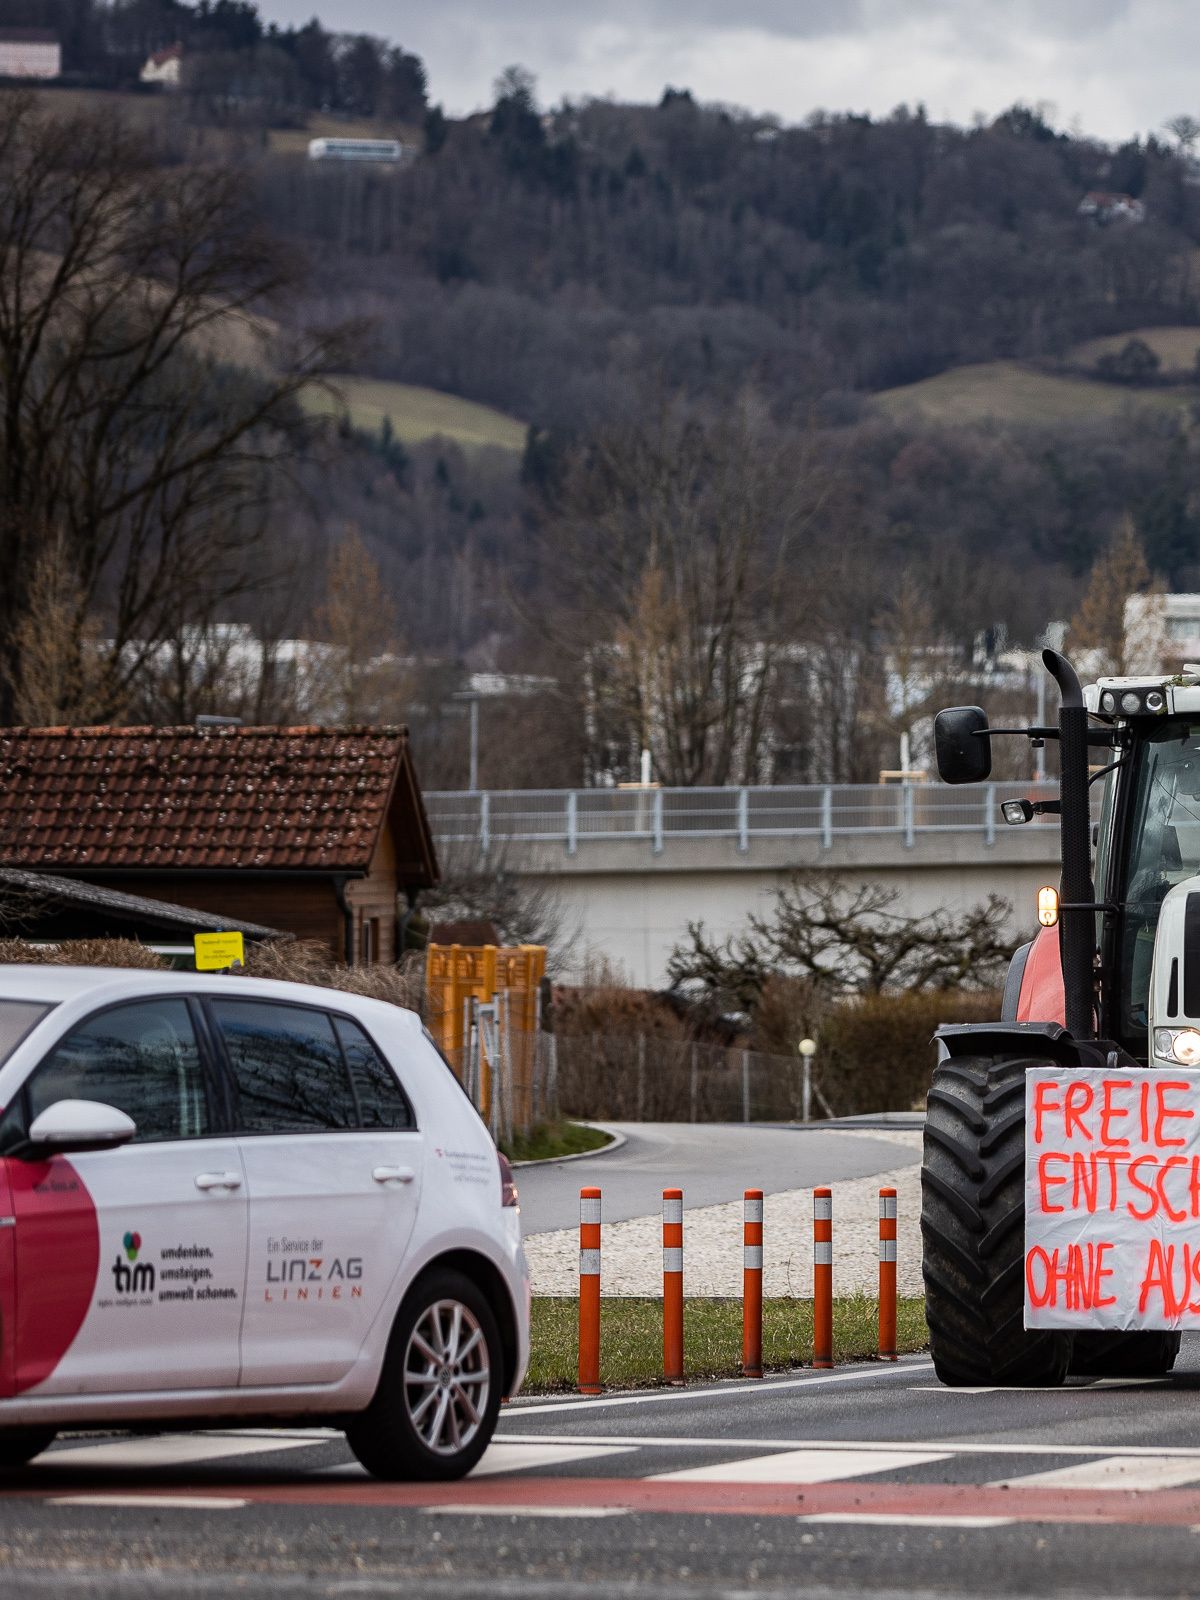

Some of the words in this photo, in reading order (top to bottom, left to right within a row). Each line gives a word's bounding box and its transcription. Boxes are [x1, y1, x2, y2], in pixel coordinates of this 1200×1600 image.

[1034, 1080, 1194, 1147] FREIE
[282, 1236, 309, 1252] Service
[112, 1254, 155, 1293] tim
[328, 1257, 363, 1279] AG
[1026, 1242, 1116, 1309] OHNE
[264, 1286, 362, 1302] LINIEN
